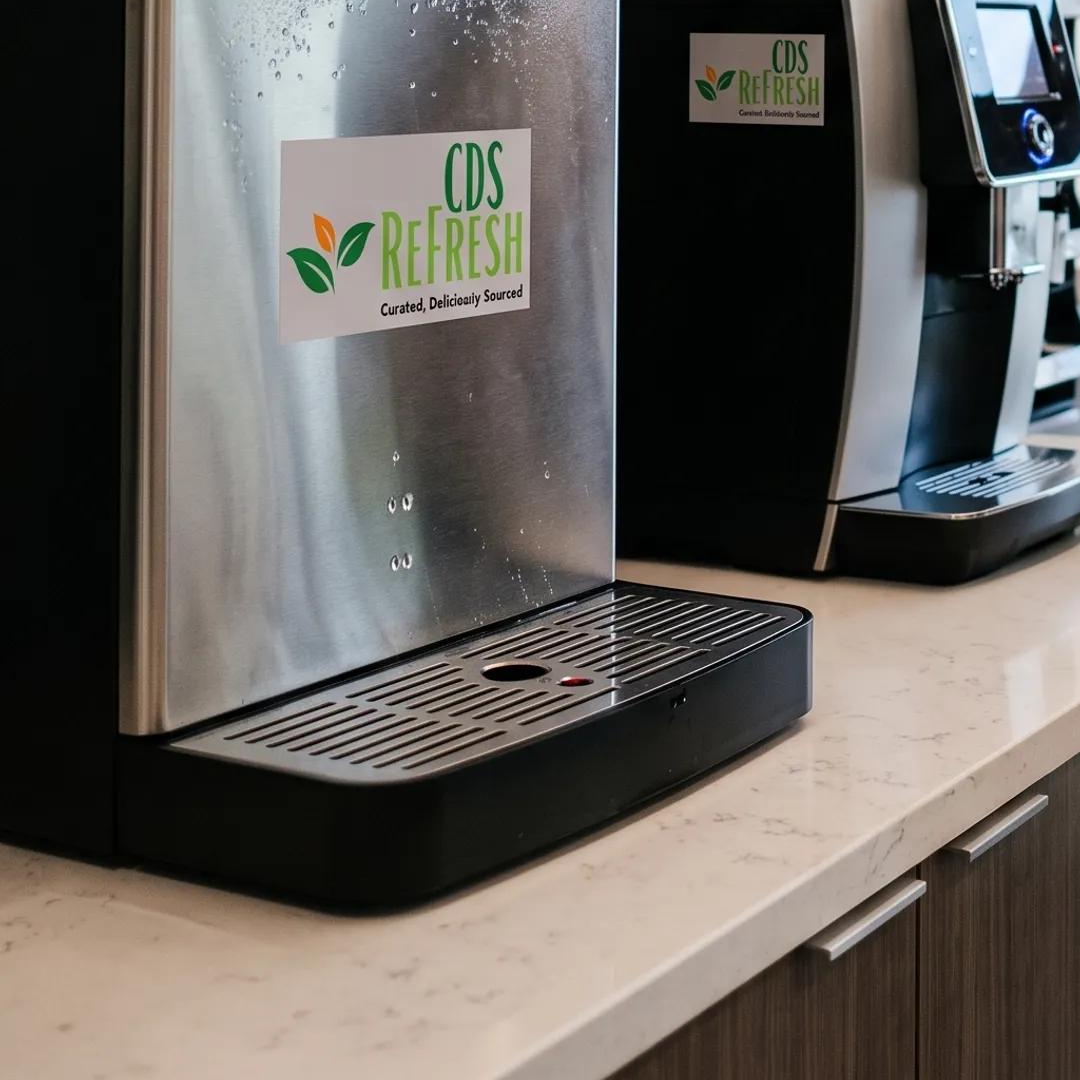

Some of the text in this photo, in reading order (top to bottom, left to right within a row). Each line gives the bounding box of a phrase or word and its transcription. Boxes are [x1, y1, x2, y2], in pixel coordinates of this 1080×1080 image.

[772, 39, 809, 75] CDS
[444, 140, 504, 213] CDS
[380, 297, 427, 317] Curated,
[483, 283, 523, 303] Sourced
